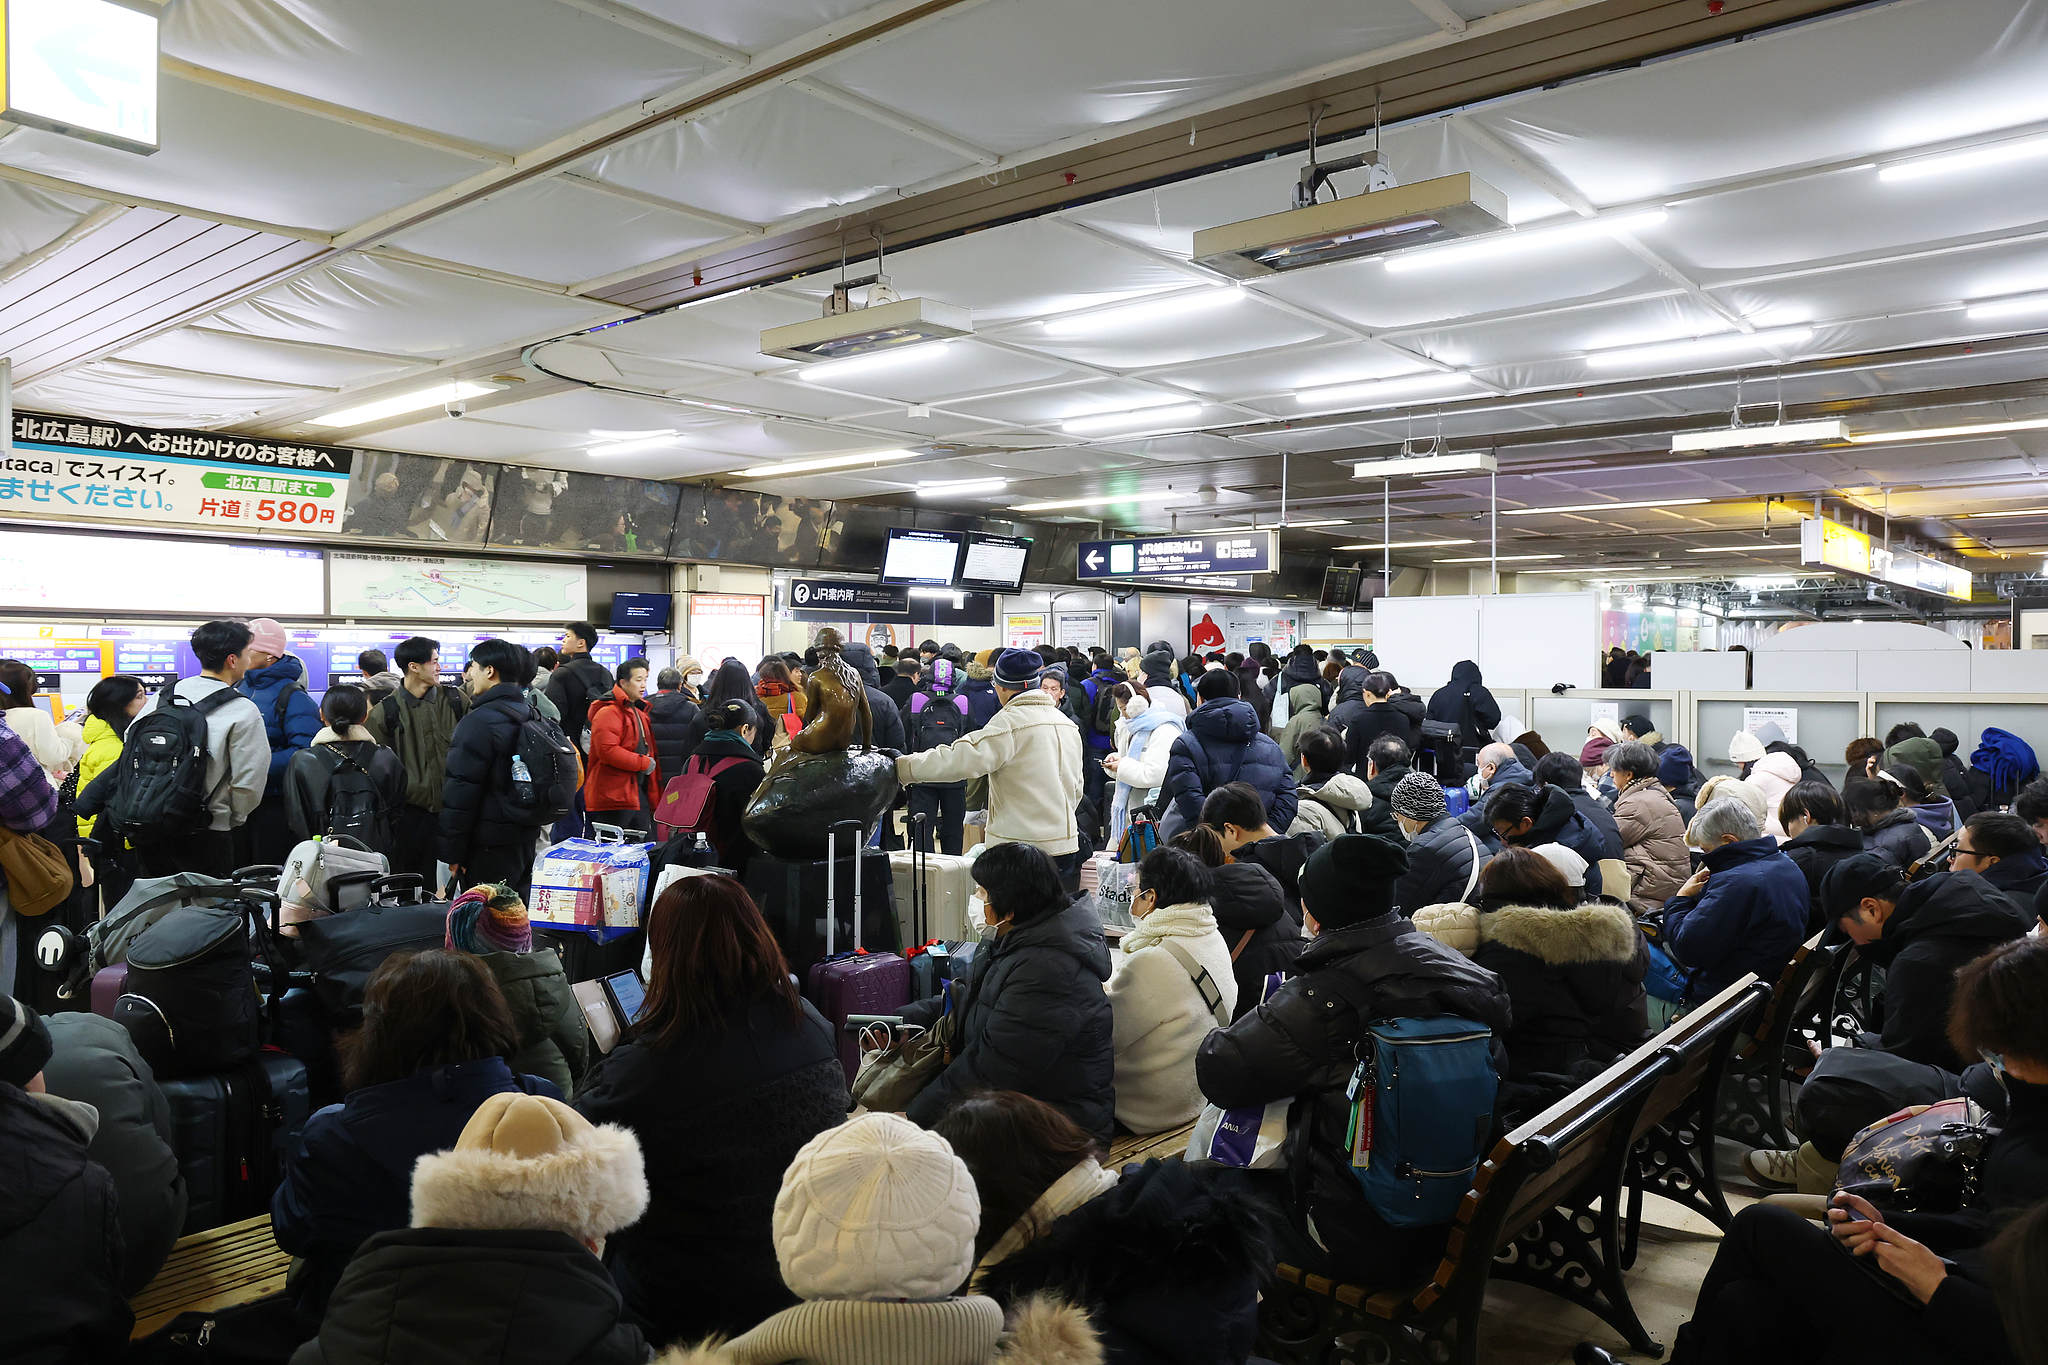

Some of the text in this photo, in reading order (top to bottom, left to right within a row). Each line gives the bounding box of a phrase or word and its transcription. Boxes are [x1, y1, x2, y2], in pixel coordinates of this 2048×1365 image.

[0, 457, 175, 486] taca」でスイスイ。
[224, 475, 318, 496] 北広島駅まで
[198, 497, 242, 519] 片道
[255, 498, 336, 525] 580円
[812, 586, 855, 603] JR案内所
[1221, 1121, 1240, 1133] ANA
